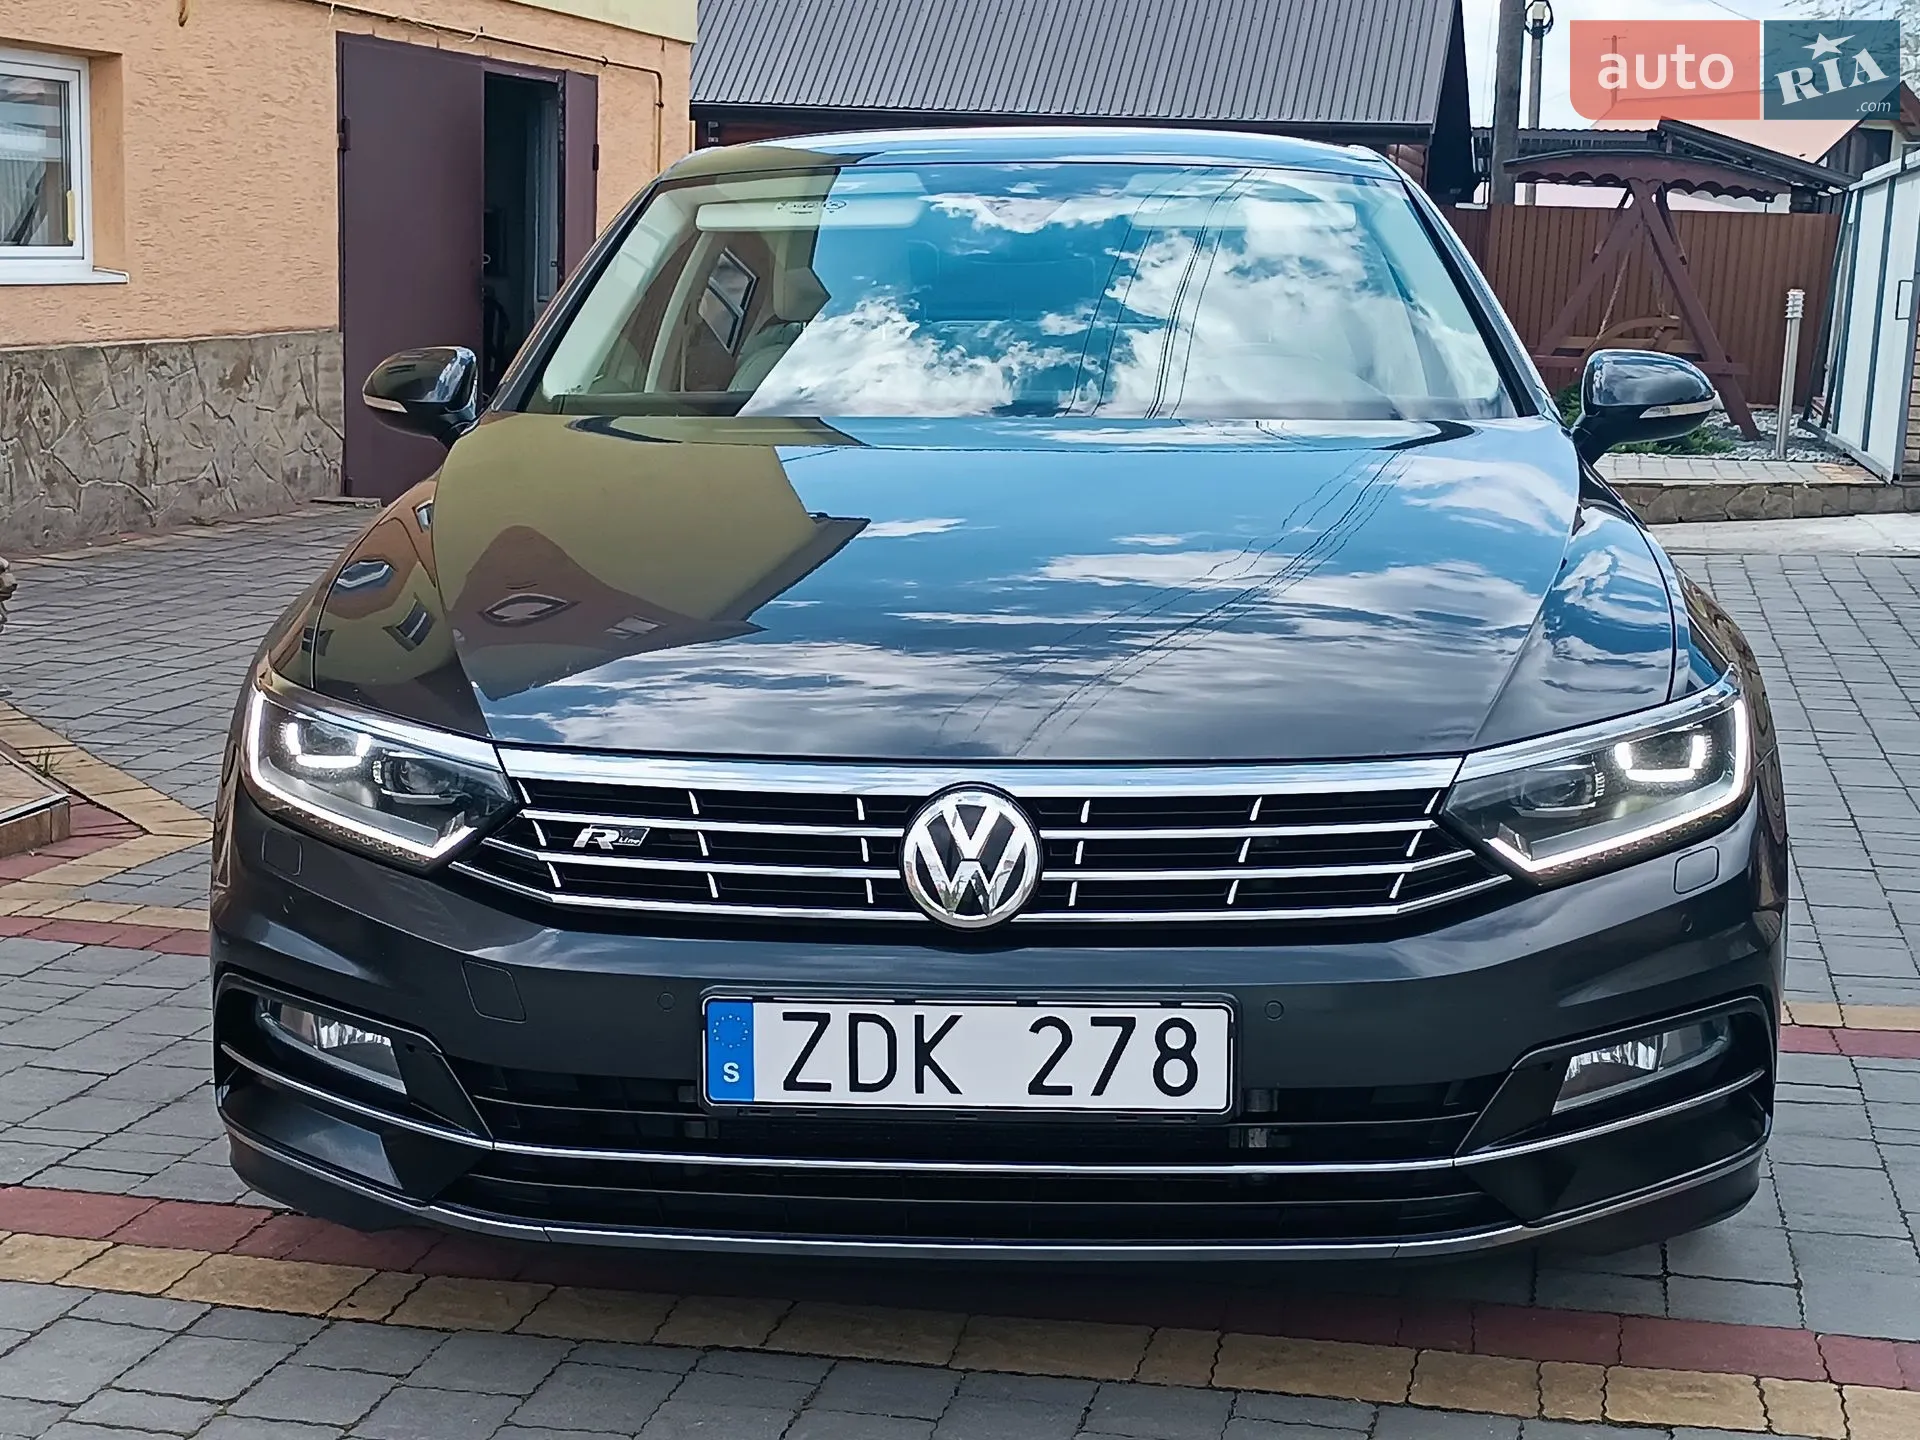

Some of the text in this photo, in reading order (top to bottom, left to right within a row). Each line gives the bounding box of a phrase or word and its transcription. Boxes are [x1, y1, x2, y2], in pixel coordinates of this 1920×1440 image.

[723, 1062, 739, 1084] S
[782, 1012, 1199, 1097] ZDK 278
